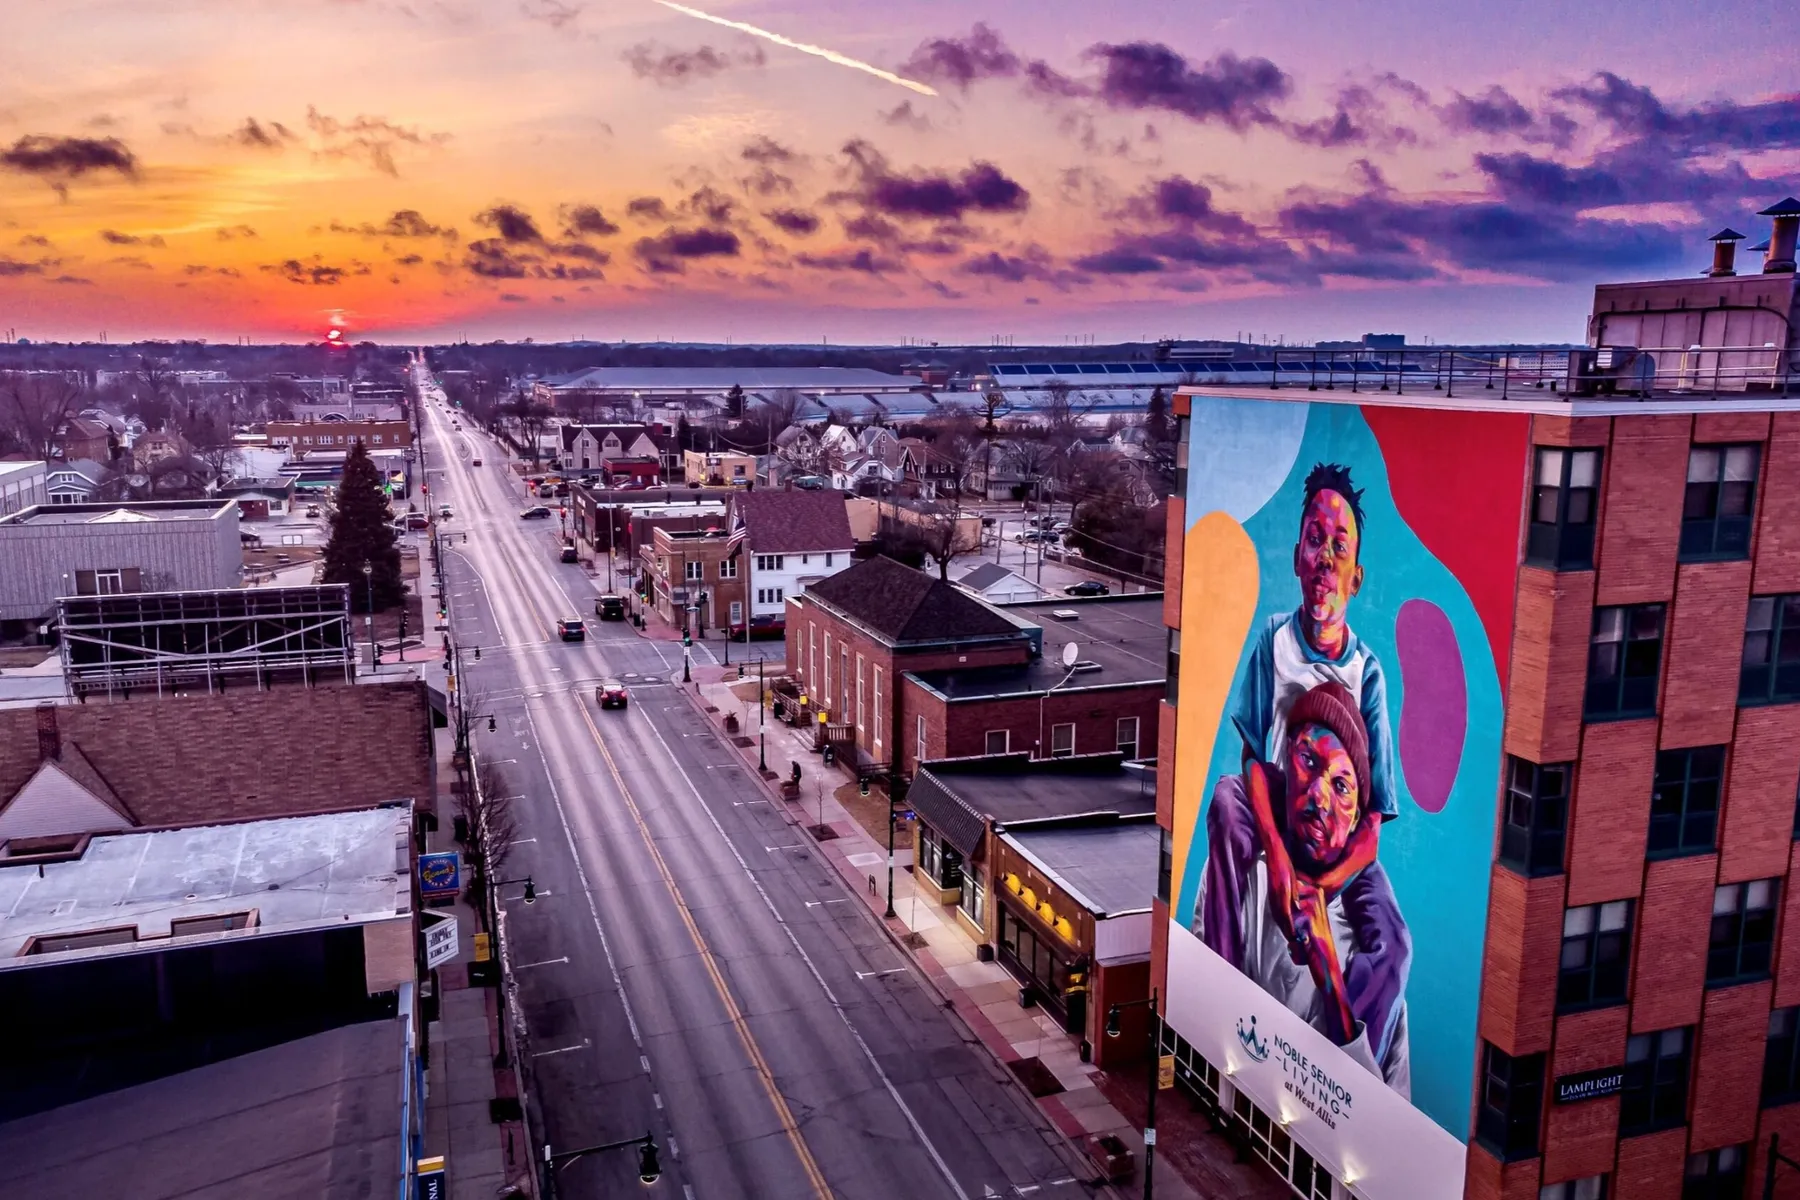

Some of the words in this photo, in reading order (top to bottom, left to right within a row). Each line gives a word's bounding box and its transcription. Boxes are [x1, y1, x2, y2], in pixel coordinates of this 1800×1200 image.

[1274, 1033, 1308, 1071] NOBLE
[1311, 1064, 1353, 1108] SENIOR
[1283, 1058, 1340, 1115] LIVING
[1561, 1074, 1624, 1096] LAMPLIGHT
[1284, 1081, 1293, 1093] at
[1295, 1085, 1315, 1111] West
[1315, 1107, 1336, 1130] Allis
